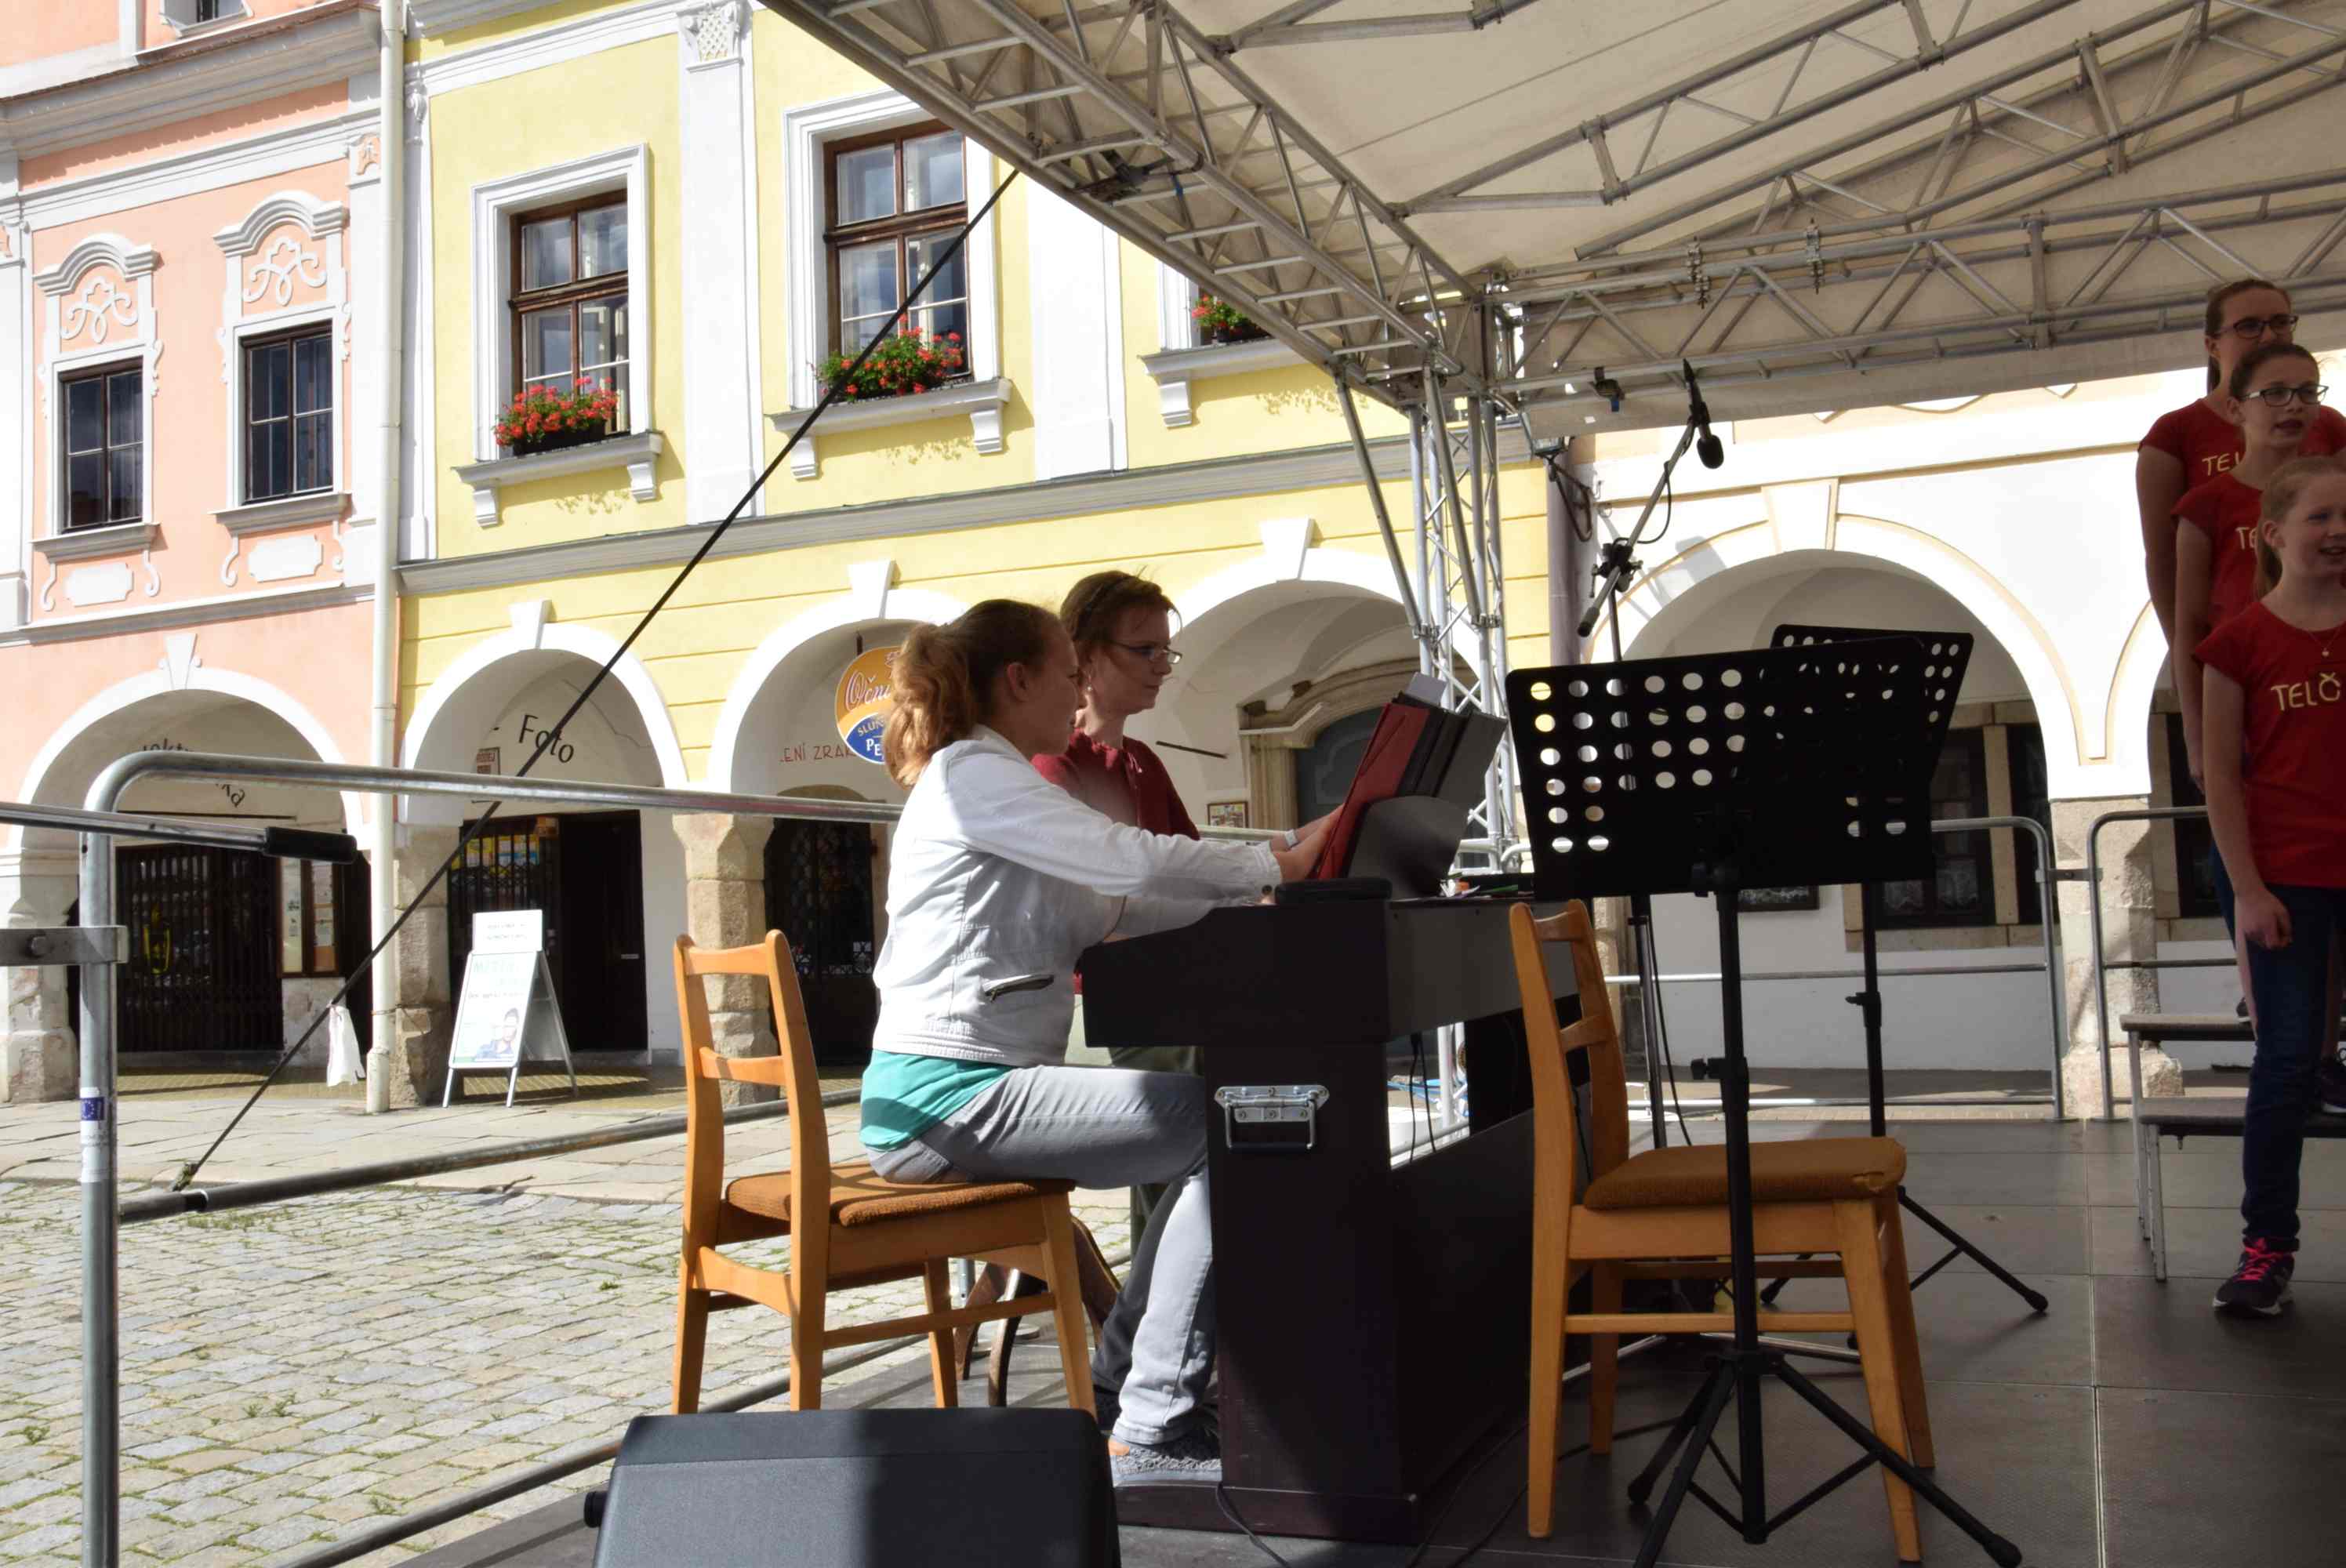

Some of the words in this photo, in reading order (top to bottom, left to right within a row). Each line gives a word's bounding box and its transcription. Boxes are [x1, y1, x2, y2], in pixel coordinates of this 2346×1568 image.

[2270, 672, 2341, 712] TELČ
[518, 714, 575, 764] Foto
[780, 742, 806, 762] ENÍ
